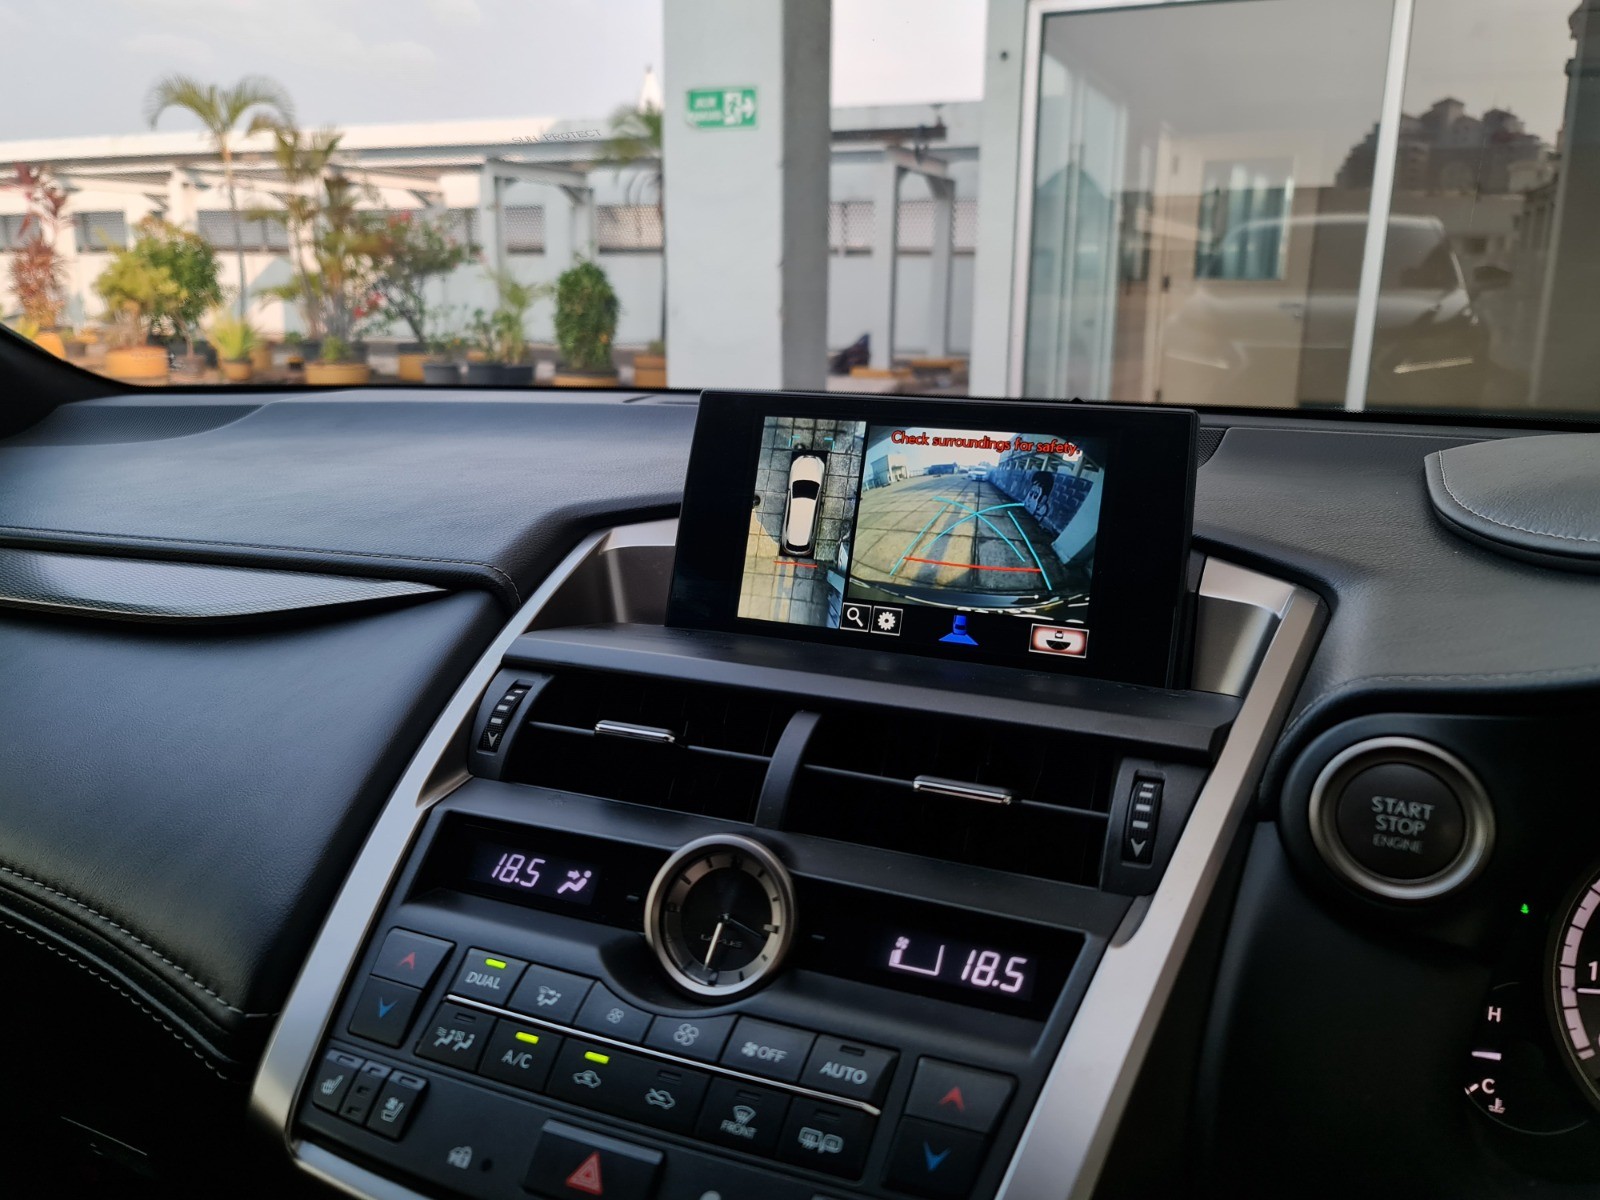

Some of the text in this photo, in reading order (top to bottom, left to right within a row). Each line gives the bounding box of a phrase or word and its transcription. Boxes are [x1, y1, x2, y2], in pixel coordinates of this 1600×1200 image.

[511, 129, 602, 144] SUN PROTECT
[891, 430, 1081, 456] Check surroundings for safety.
[1372, 796, 1434, 820] START
[1376, 814, 1426, 836] STOP
[1372, 833, 1423, 853] ENGINE
[491, 853, 546, 888] 18.5
[466, 971, 501, 991] DUAL
[960, 949, 1027, 993] 18.5
[1487, 1005, 1501, 1023] H
[502, 1049, 533, 1070] A/C
[757, 1045, 788, 1063] OFF
[820, 1061, 868, 1085] AUTO
[1481, 1078, 1496, 1094] C
[720, 1119, 758, 1140] FRONT
